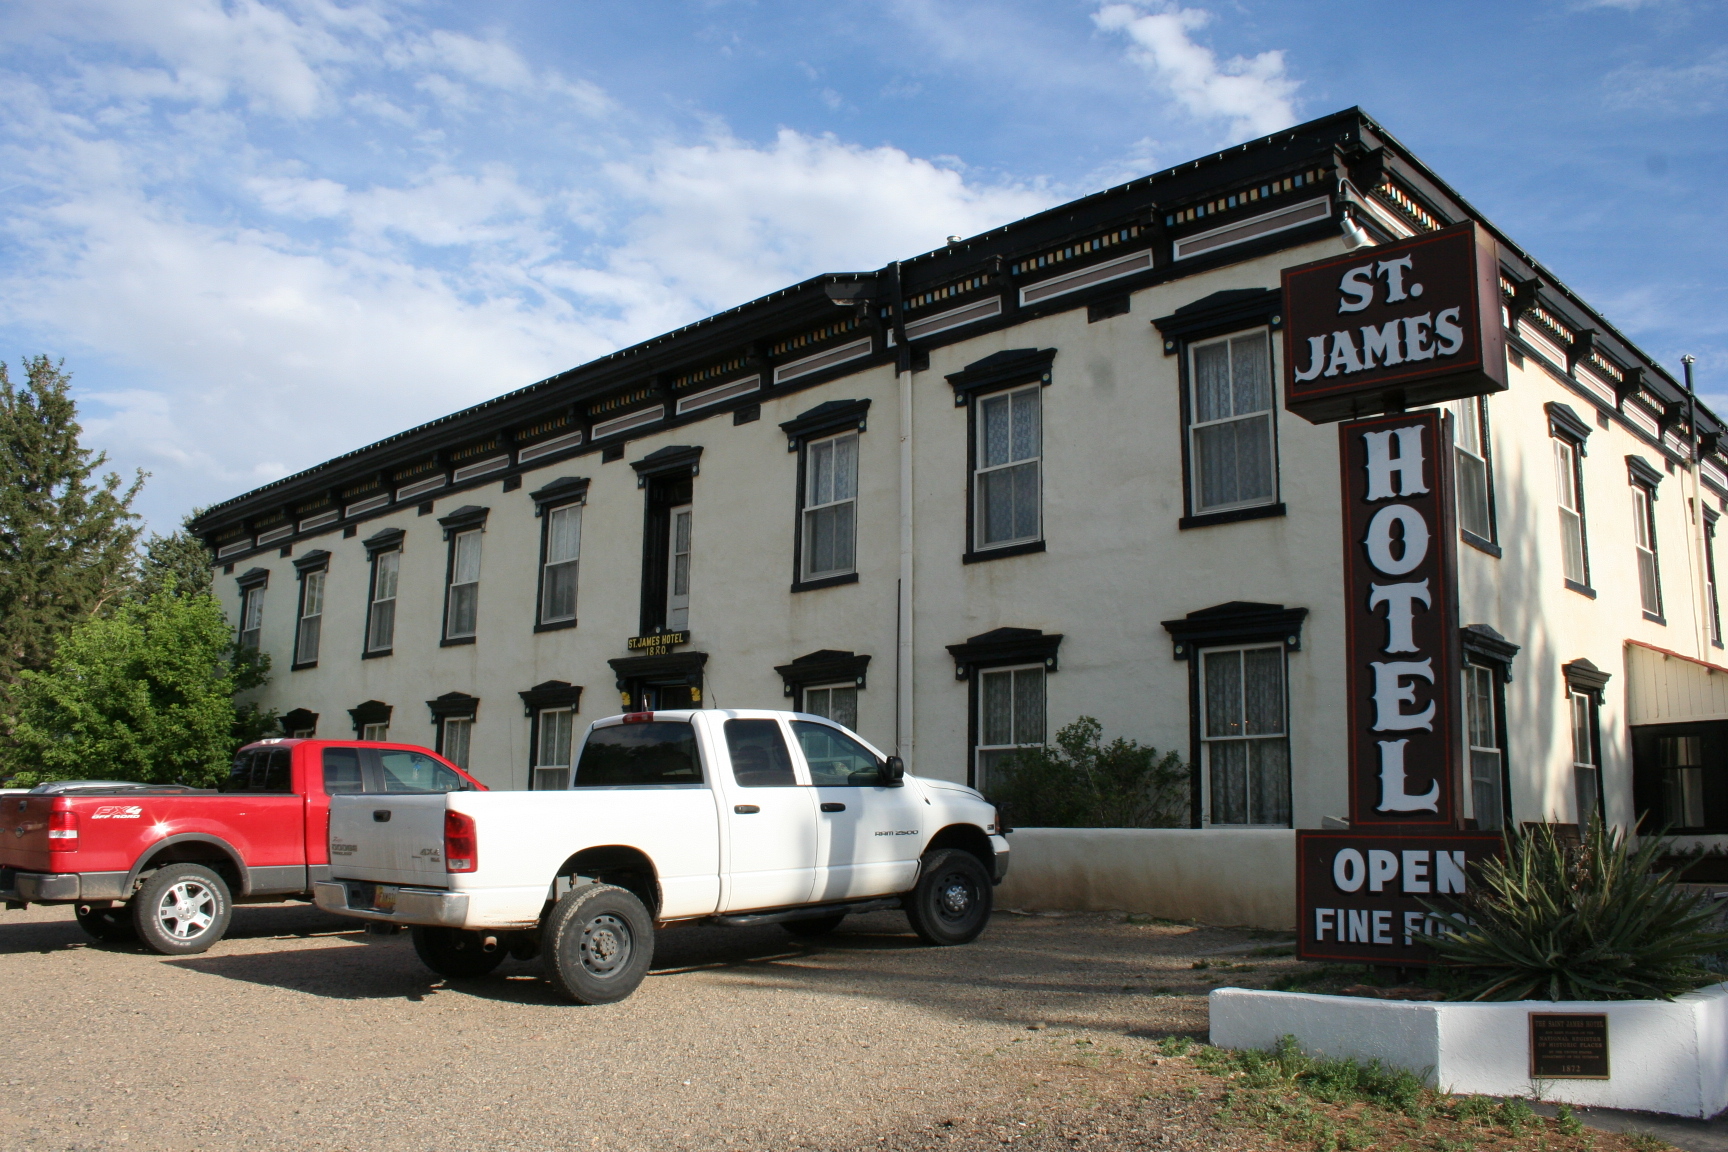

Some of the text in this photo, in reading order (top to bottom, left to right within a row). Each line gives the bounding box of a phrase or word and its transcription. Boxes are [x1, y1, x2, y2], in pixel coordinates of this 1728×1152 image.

[1338, 253, 1424, 314] ST.
[1295, 306, 1464, 384] JAMES
[638, 636, 660, 648] JAMES
[662, 633, 683, 644] HOTEL
[1362, 424, 1440, 814] HOTEL
[93, 806, 142, 815] FX4
[1333, 847, 1466, 894] OPEN
[1315, 907, 1393, 945] FINE
